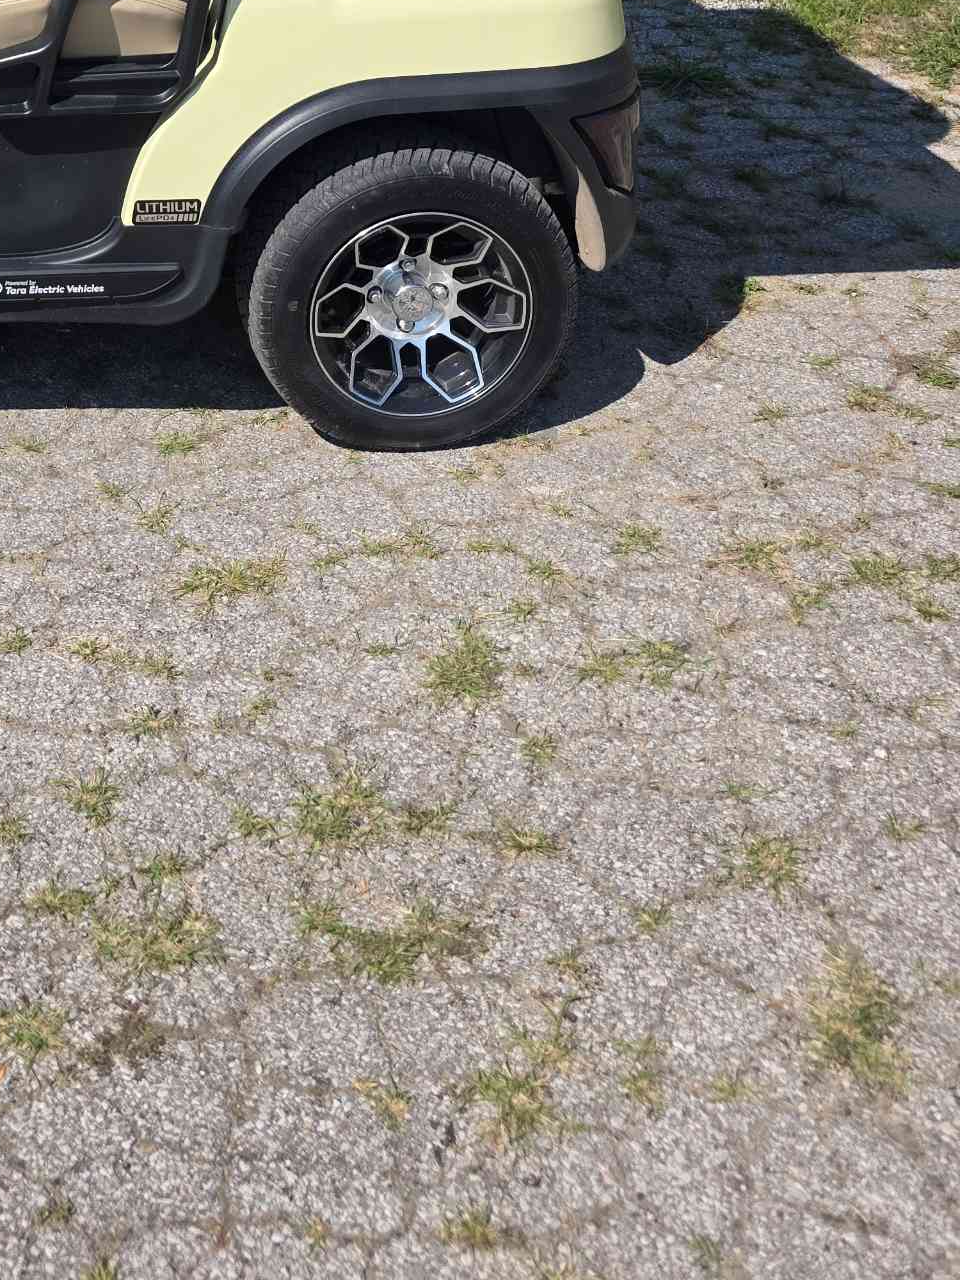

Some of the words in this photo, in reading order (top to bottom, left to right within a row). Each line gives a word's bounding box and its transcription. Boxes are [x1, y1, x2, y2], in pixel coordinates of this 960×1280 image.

[137, 201, 198, 213] LITHIUM
[5, 286, 26, 295] Tara
[29, 285, 65, 294] Electric
[66, 284, 105, 293] Vehicles
